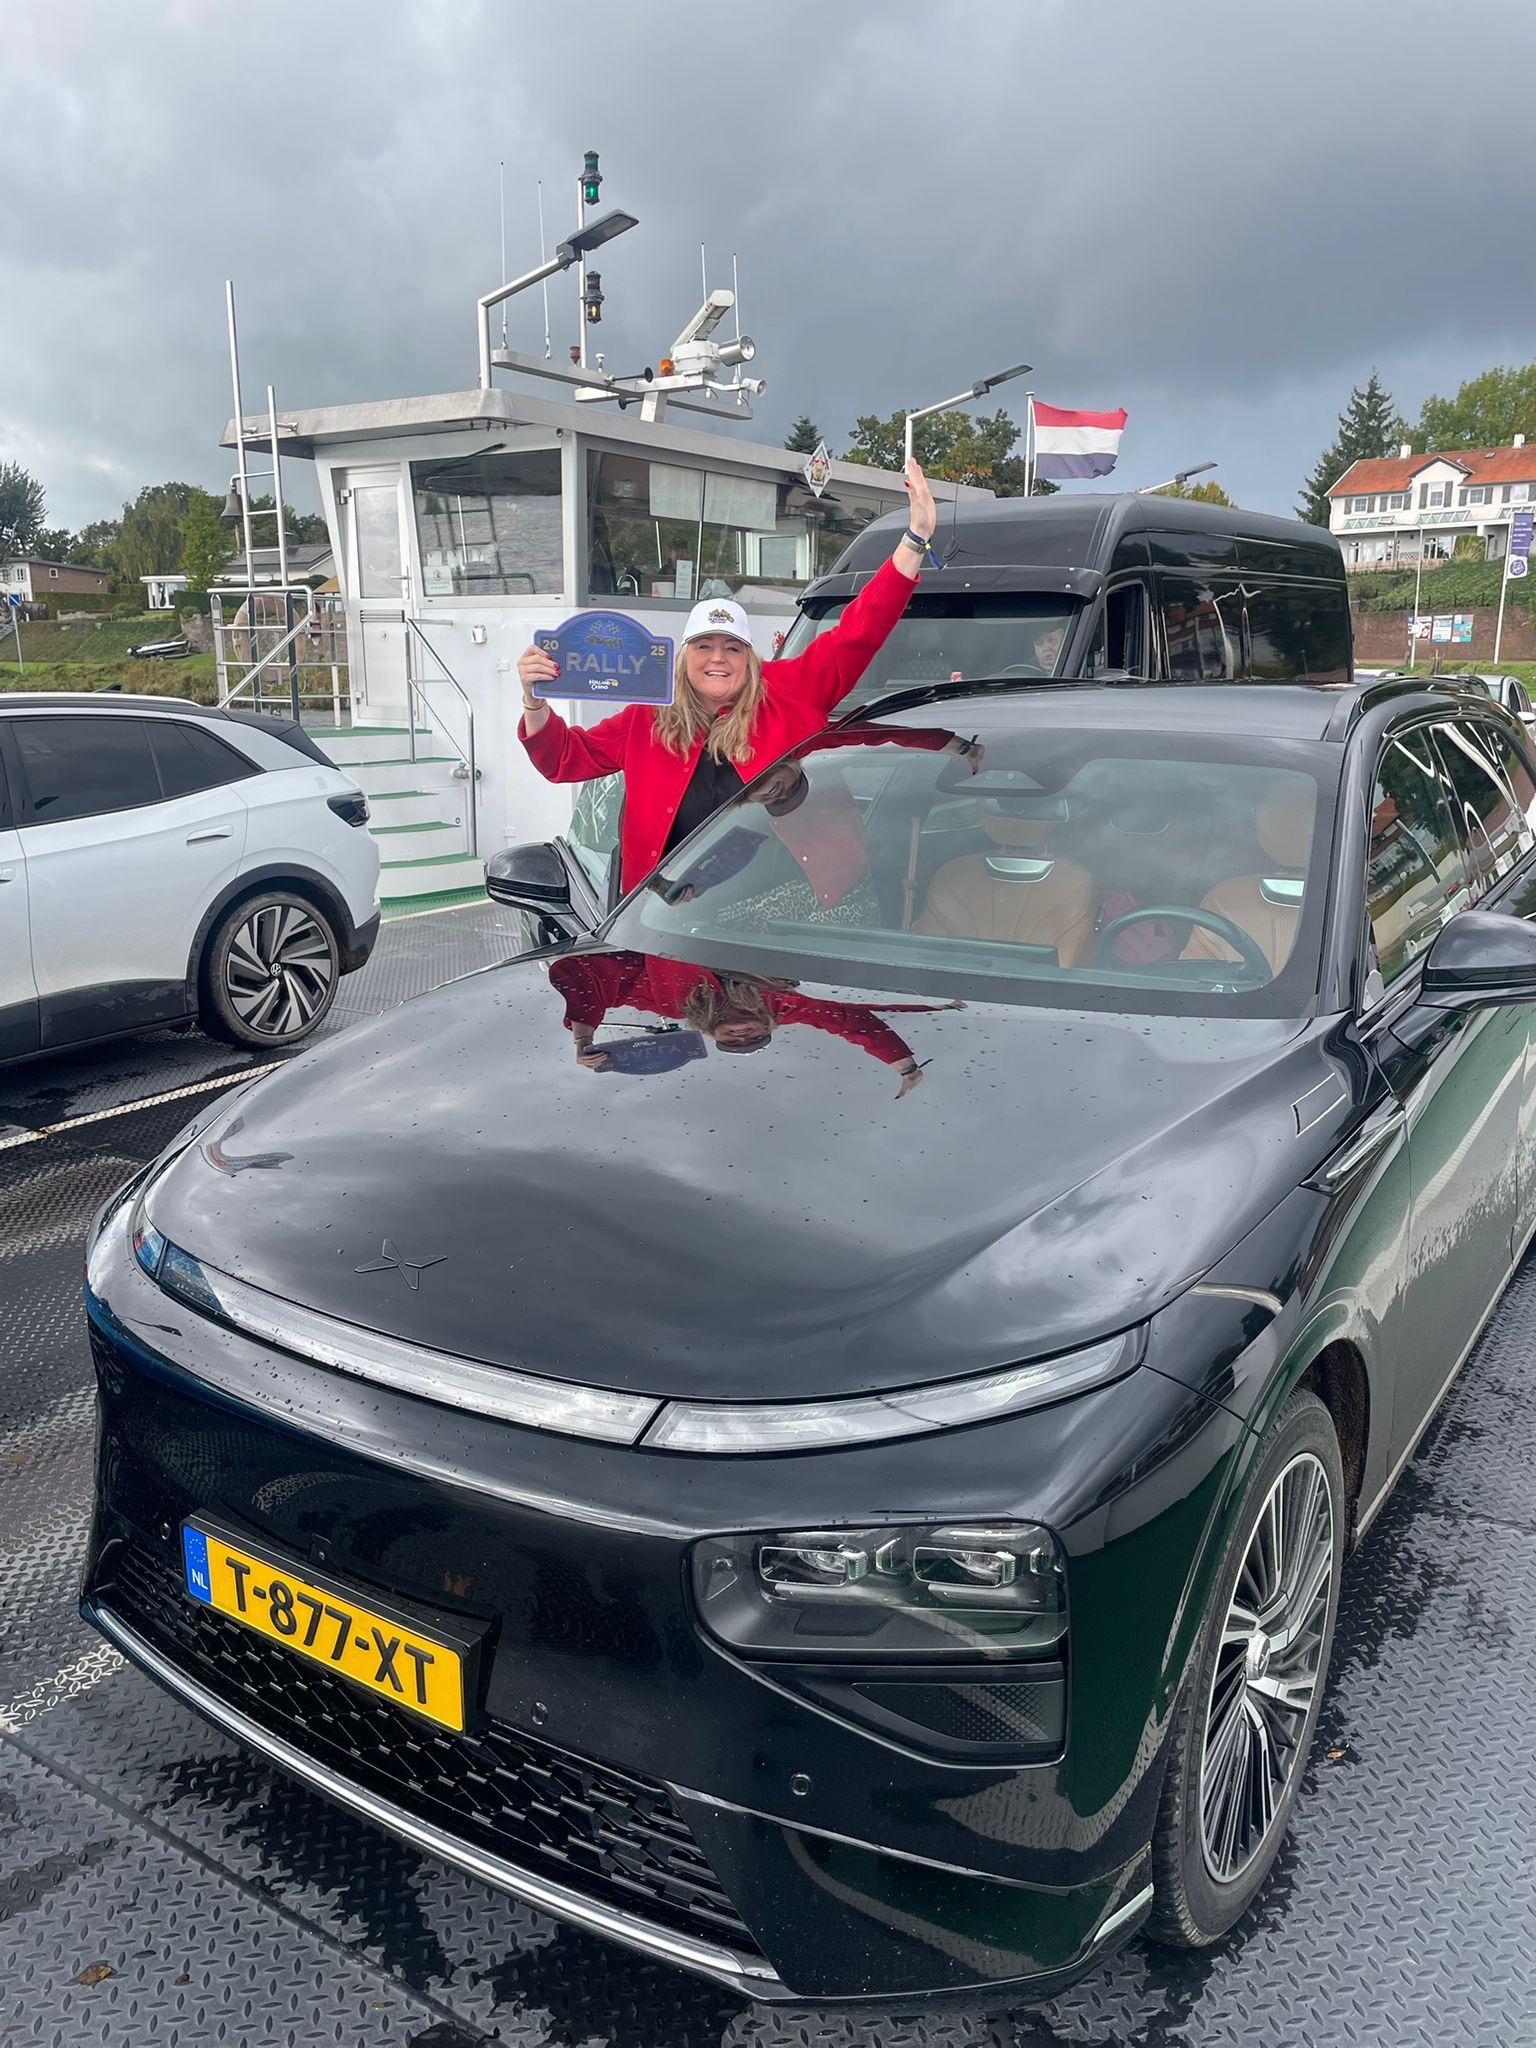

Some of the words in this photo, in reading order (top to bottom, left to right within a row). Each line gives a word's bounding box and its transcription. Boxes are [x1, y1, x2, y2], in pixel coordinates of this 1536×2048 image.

[543, 639, 559, 650] 20
[650, 645, 666, 656] 25
[566, 651, 647, 675] RALLY
[191, 1568, 208, 1590] NL
[226, 1556, 434, 1704] T-877-XT
